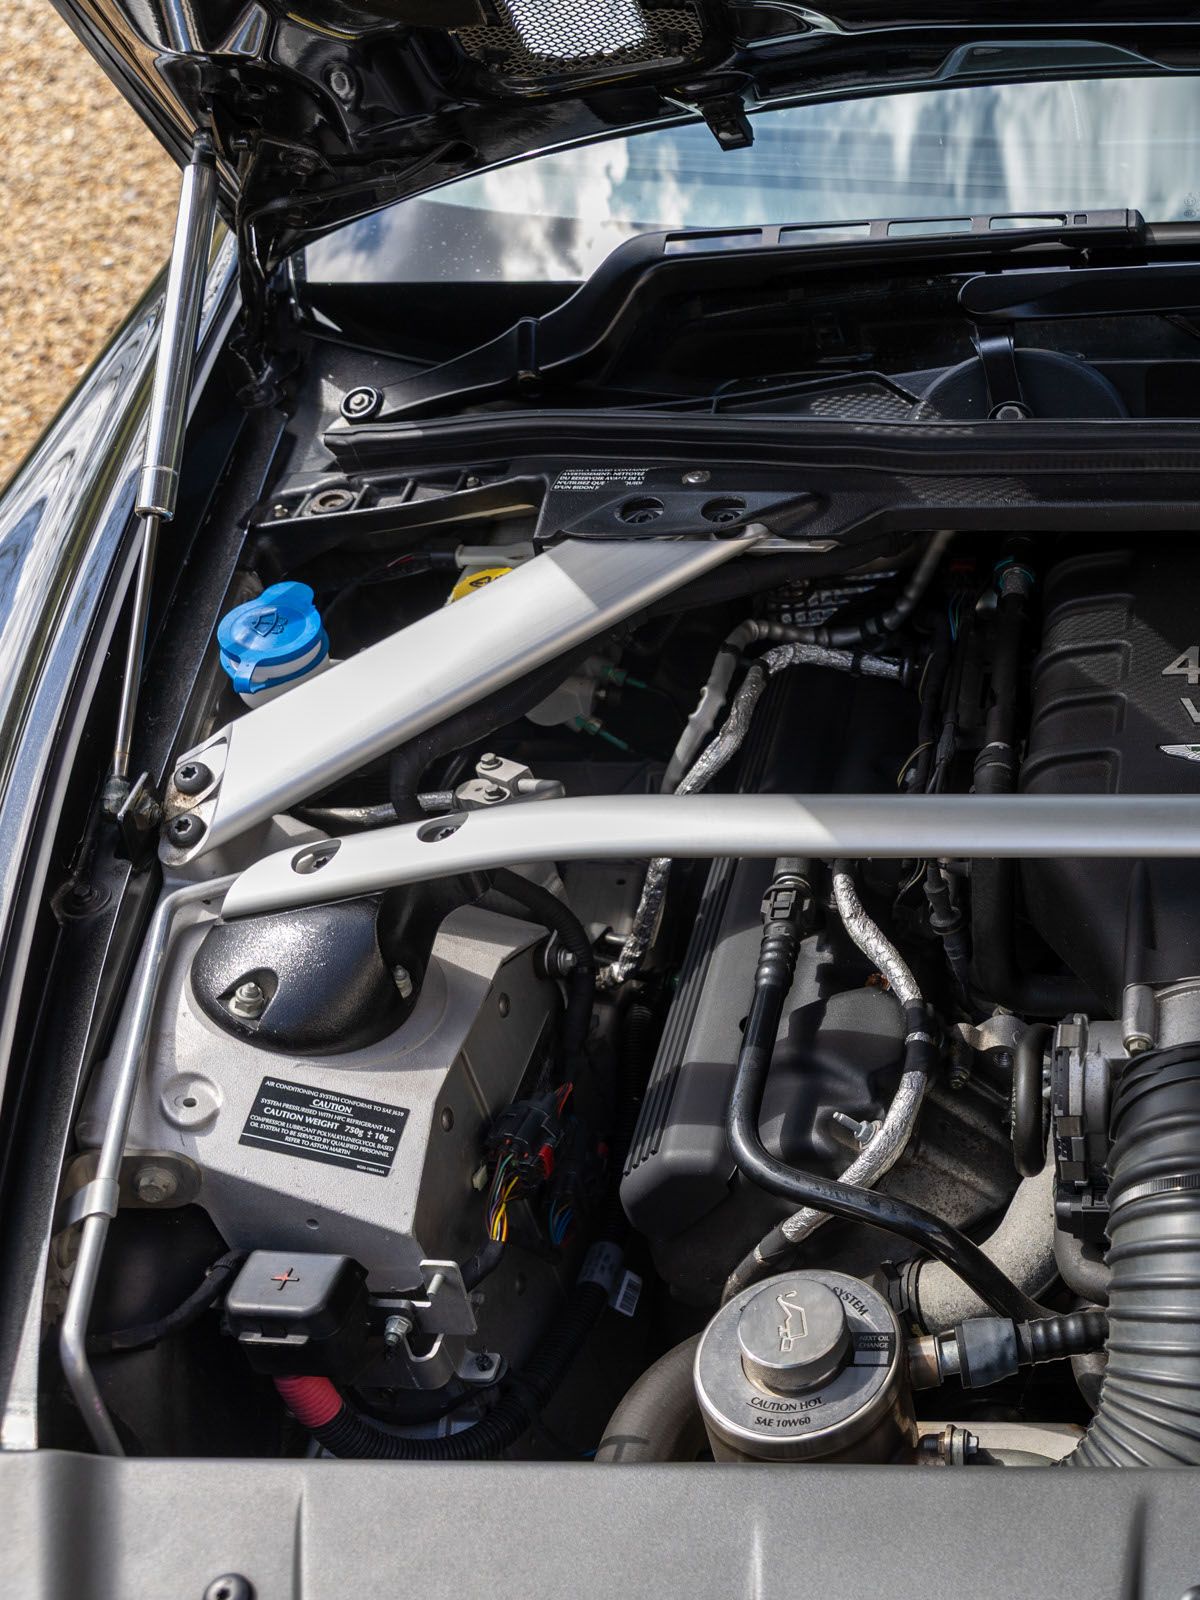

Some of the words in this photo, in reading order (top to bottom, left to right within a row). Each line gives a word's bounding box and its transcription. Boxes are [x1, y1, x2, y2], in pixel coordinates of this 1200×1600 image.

[275, 1083, 318, 1096] CONDITIONING
[318, 1093, 339, 1101] SYSTEM
[340, 1098, 372, 1109] CONFORMS
[312, 1099, 352, 1113] CAUTION
[260, 1098, 281, 1106] SYSTEM
[281, 1103, 317, 1115] PRESSURISED
[346, 1117, 382, 1130] REFRIGERANT
[263, 1106, 304, 1121] CAUTION
[304, 1116, 339, 1129] WEIGHT
[344, 1125, 364, 1136] 750g
[374, 1133, 388, 1142] 10g
[249, 1114, 286, 1126] COMPRESSOR
[286, 1123, 316, 1133] LUBRICANT
[376, 1143, 393, 1151] BASED
[259, 1124, 280, 1132] SYSTEM
[297, 1132, 322, 1142] SERVICED
[330, 1140, 358, 1150] QUALIFIED
[359, 1146, 389, 1157] PERSONNEL
[309, 1142, 328, 1150] ASTON
[328, 1146, 350, 1154] MARTIN
[832, 1286, 869, 1316] SYSTEM
[751, 1396, 797, 1411] CAUTION
[800, 1396, 822, 1409] HOT
[755, 1416, 774, 1427] SAE
[777, 1417, 811, 1427] 10W60
